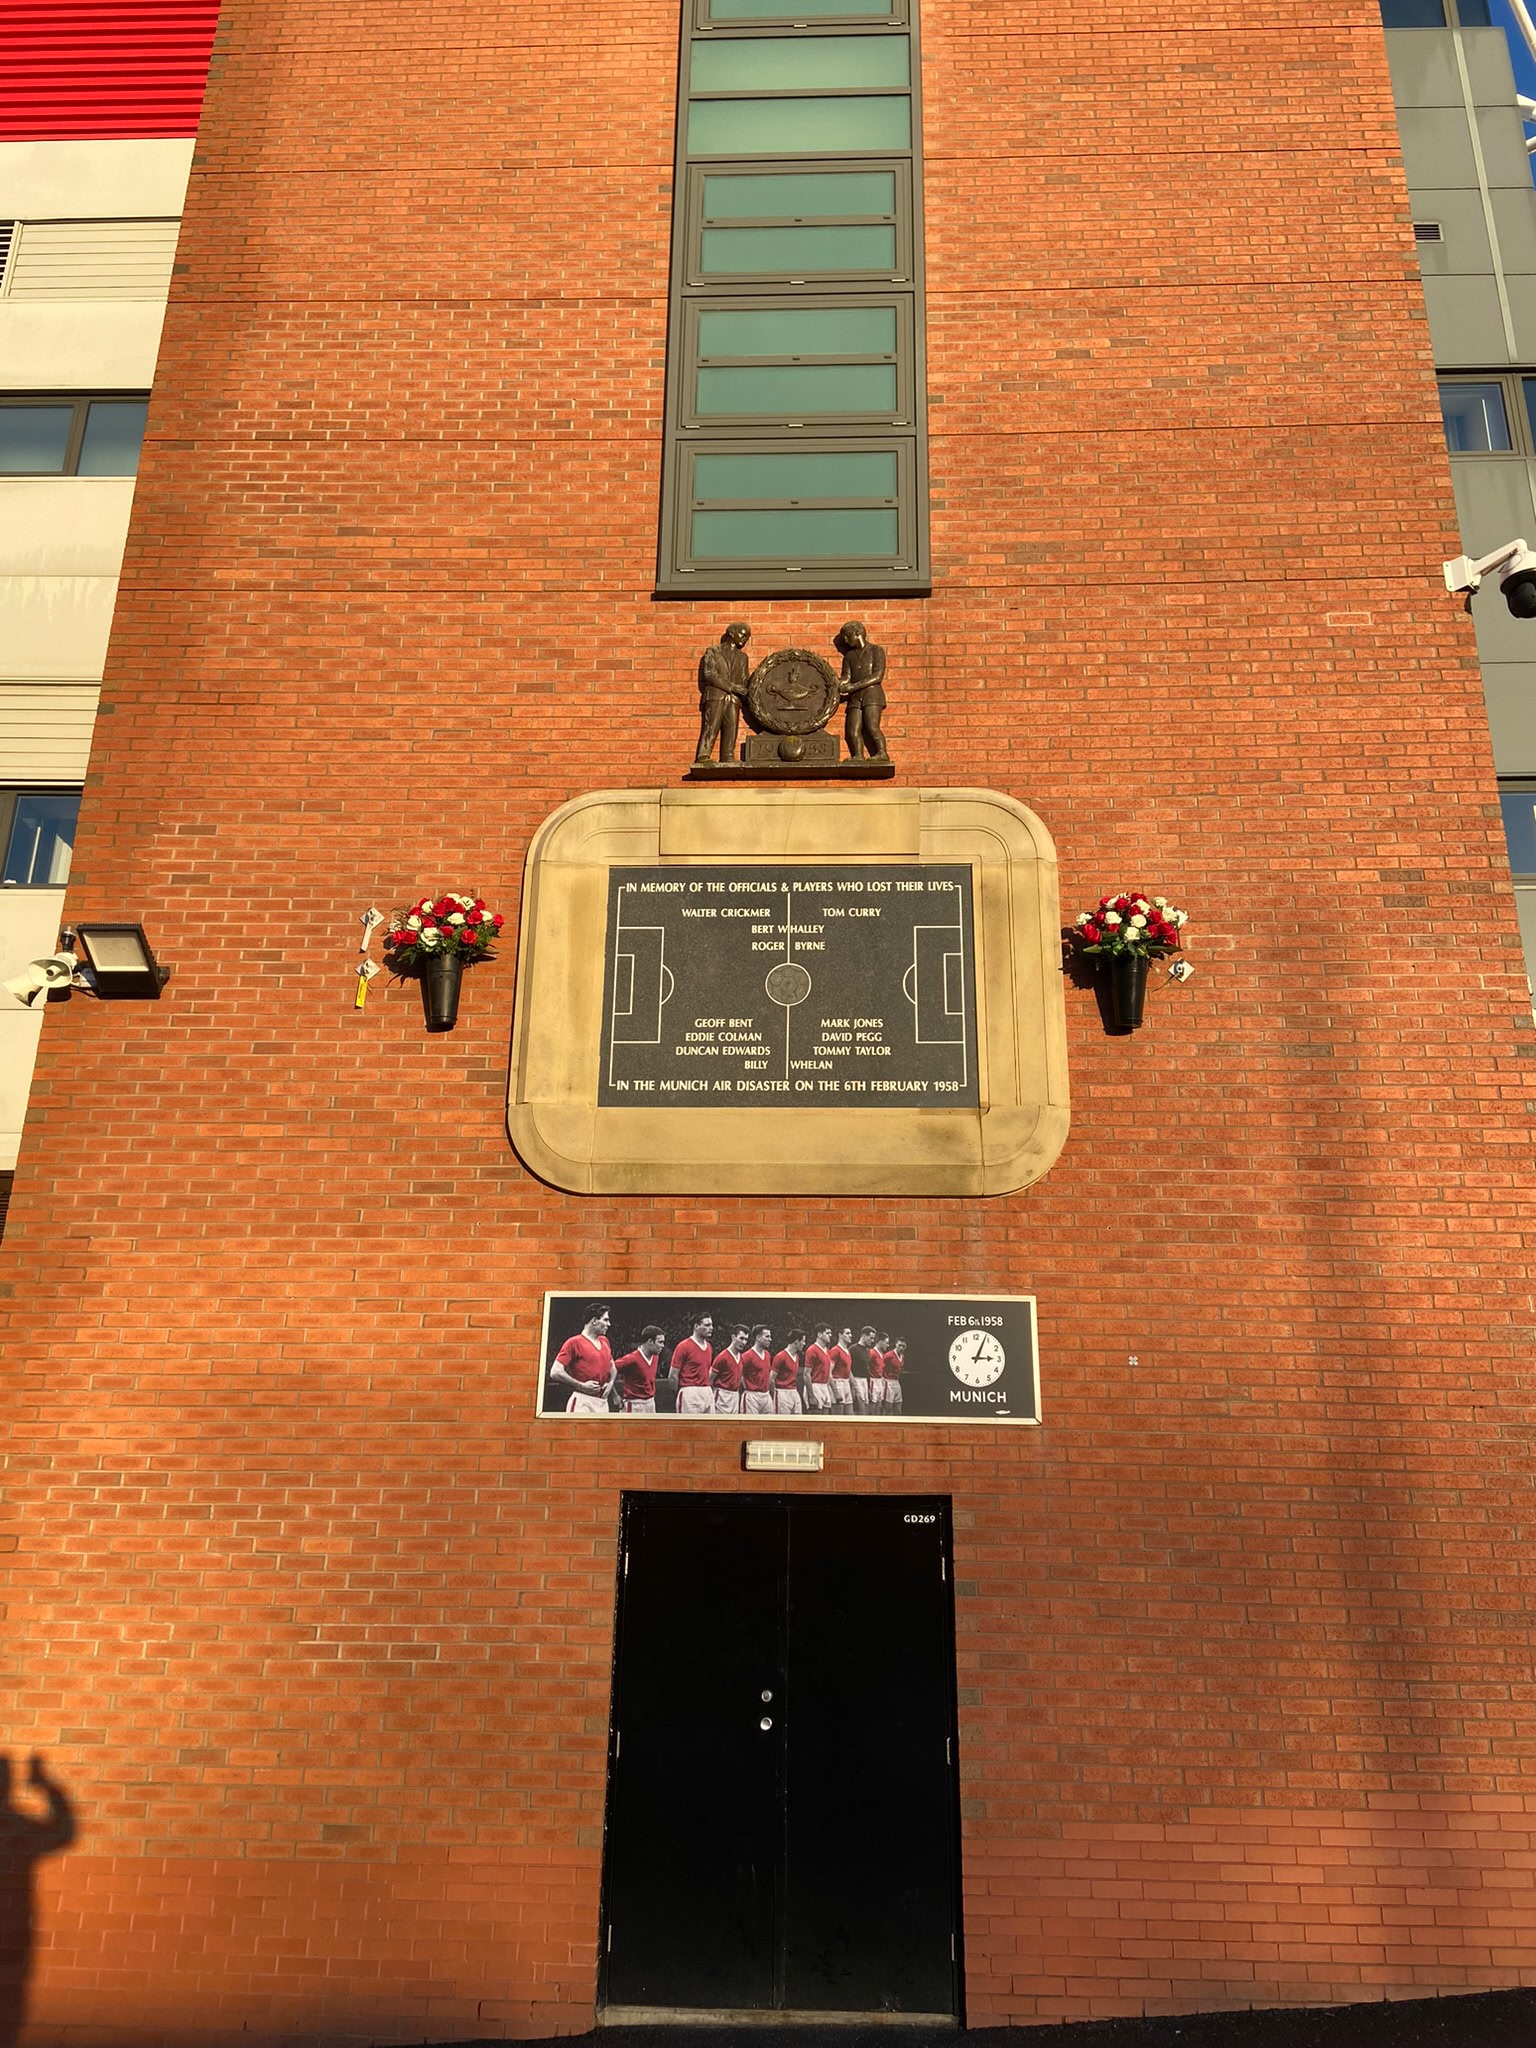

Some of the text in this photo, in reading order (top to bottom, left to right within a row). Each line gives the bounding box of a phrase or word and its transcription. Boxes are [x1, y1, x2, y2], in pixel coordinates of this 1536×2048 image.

[626, 881, 954, 893] IN MEMORY OF THE OFFICIALS & PLAYERS WHO LOST THEIR LIVES
[682, 908, 771, 918] WALTER CRICKMER
[822, 907, 881, 917] TOM CURRY
[751, 924, 825, 934] BERT WHALLEY
[751, 941, 826, 951] ROGER BYRNE
[694, 1018, 753, 1028] GEOFF BENT
[820, 1018, 883, 1029] MARK JONES
[685, 1032, 762, 1042] EDDIE COLMAN
[821, 1032, 882, 1042] DAVID PEGG
[675, 1046, 771, 1056] DUNCAN EDWARDS
[813, 1046, 891, 1056] TOMMY TAYLOR
[744, 1060, 833, 1070] BILLY WHELAN
[616, 1080, 959, 1092] IN THE MUNICH AIR DISASTER ON THE 6TH FEBRUARY 1958
[948, 1315, 967, 1326] FEB
[981, 1316, 1003, 1327] 1958
[950, 1390, 1007, 1403] MUNICH
[903, 1514, 936, 1523] GD269
